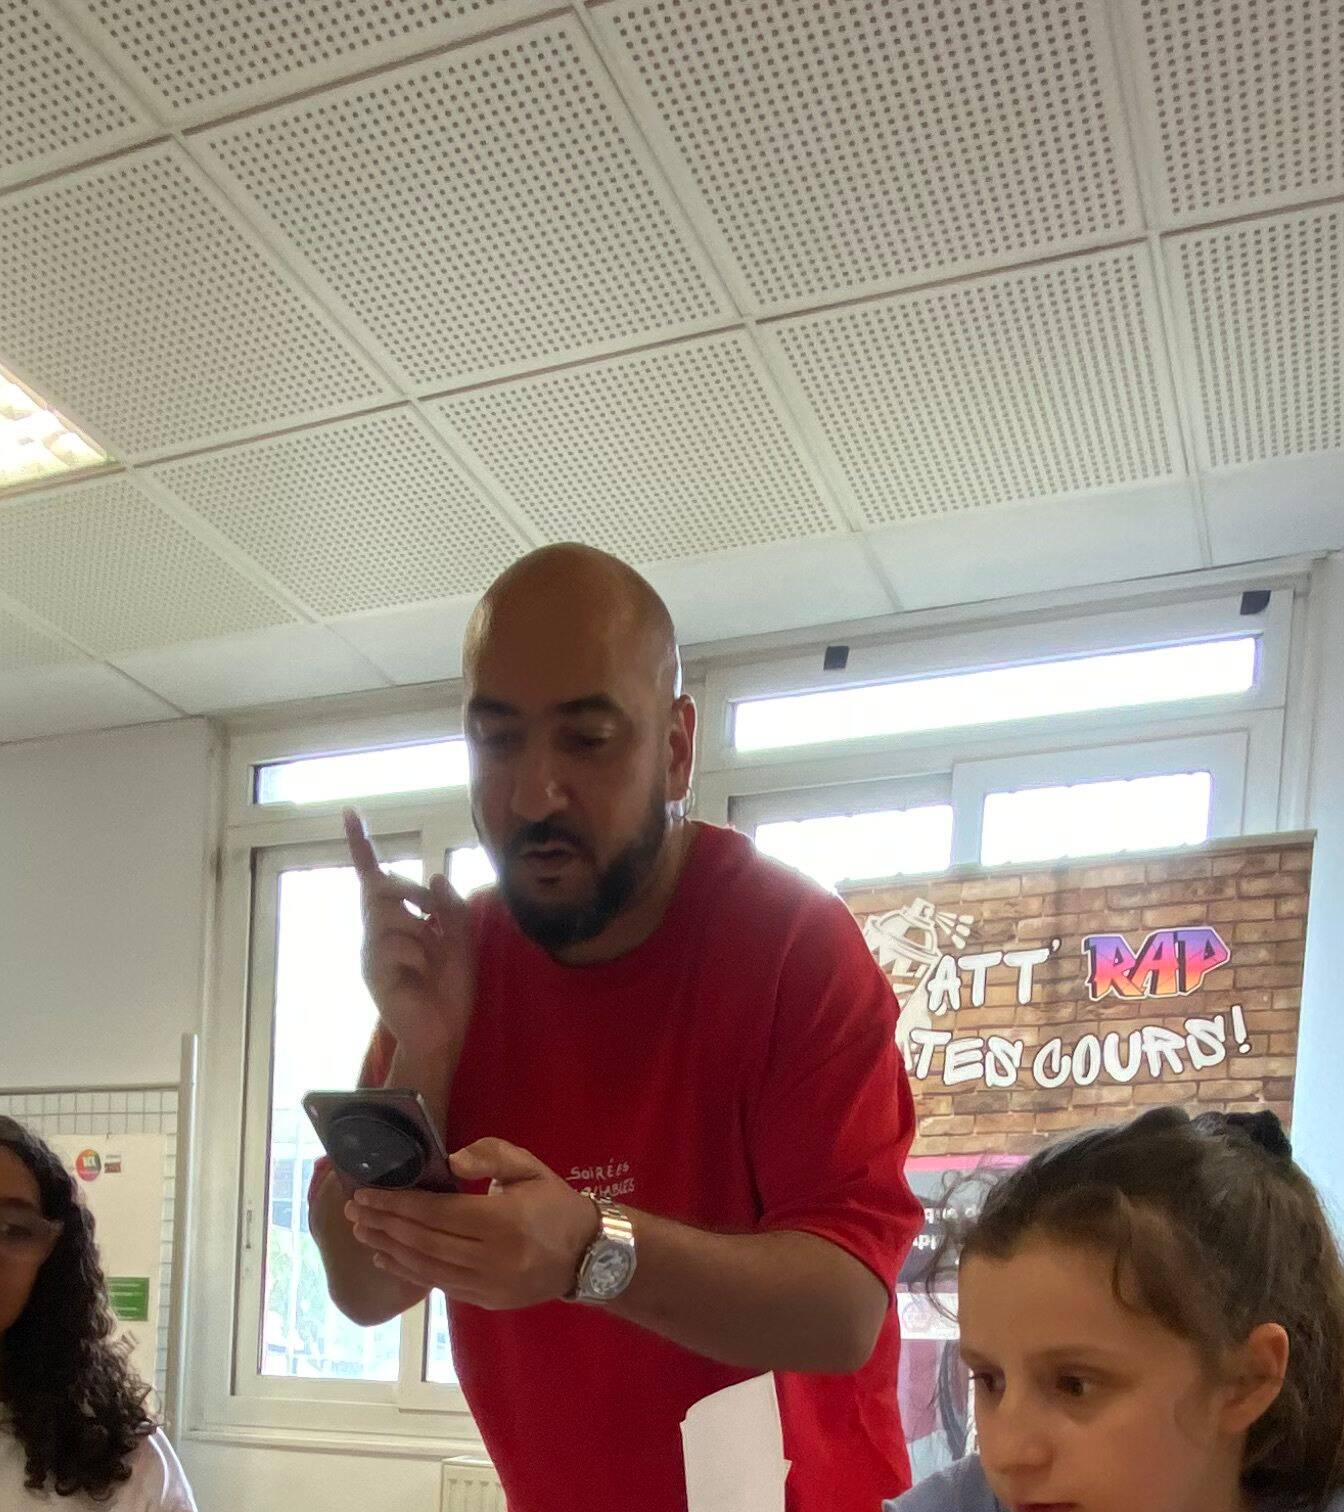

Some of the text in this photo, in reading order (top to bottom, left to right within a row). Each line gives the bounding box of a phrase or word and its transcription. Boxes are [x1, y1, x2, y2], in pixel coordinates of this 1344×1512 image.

[1081, 925, 1231, 1002] RAP
[909, 1003, 1252, 1089] TES COURS!
